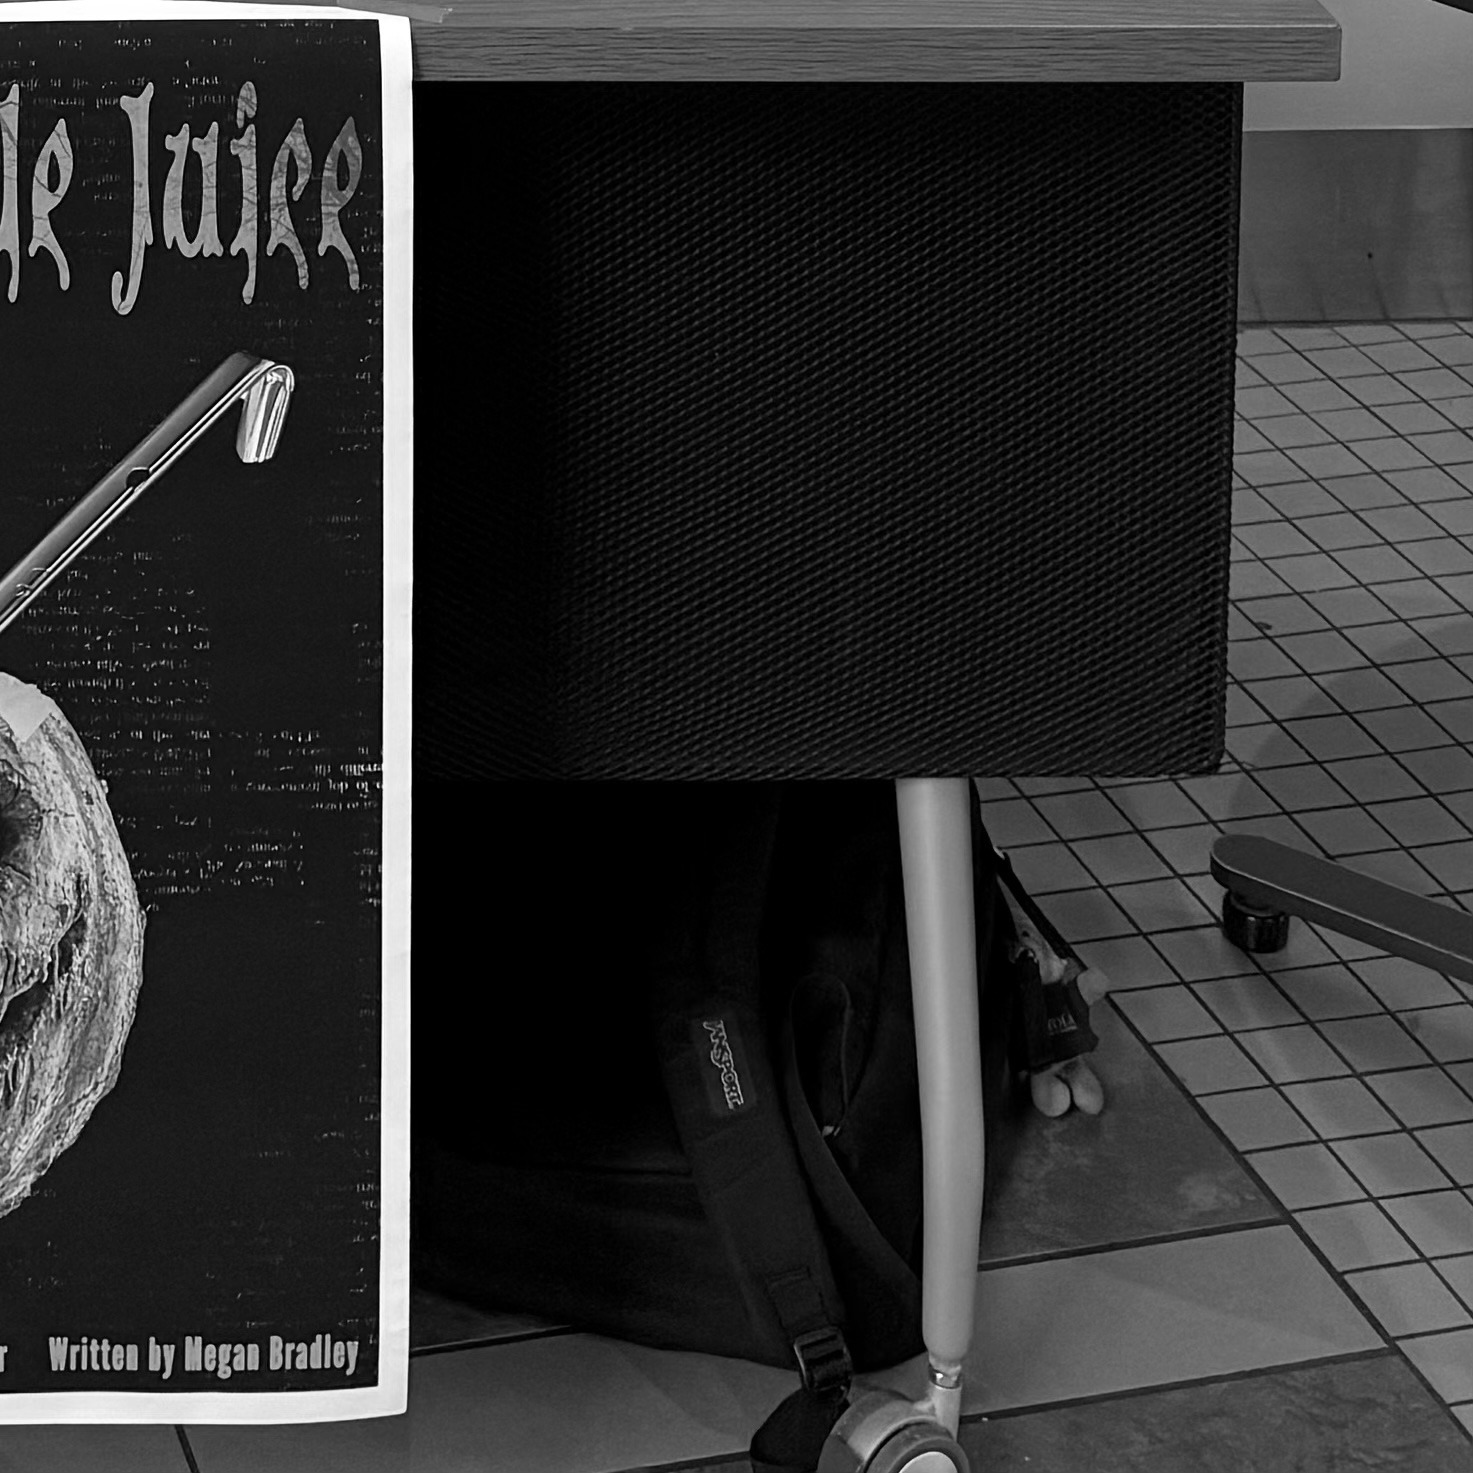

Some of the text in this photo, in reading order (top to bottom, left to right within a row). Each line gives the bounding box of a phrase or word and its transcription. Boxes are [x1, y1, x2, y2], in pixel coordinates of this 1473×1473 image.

[111, 80, 364, 318] Juice
[48, 1336, 139, 1372] Written
[148, 1336, 176, 1380] by
[184, 1336, 260, 1380] Megan
[268, 1333, 359, 1376] Bradley
